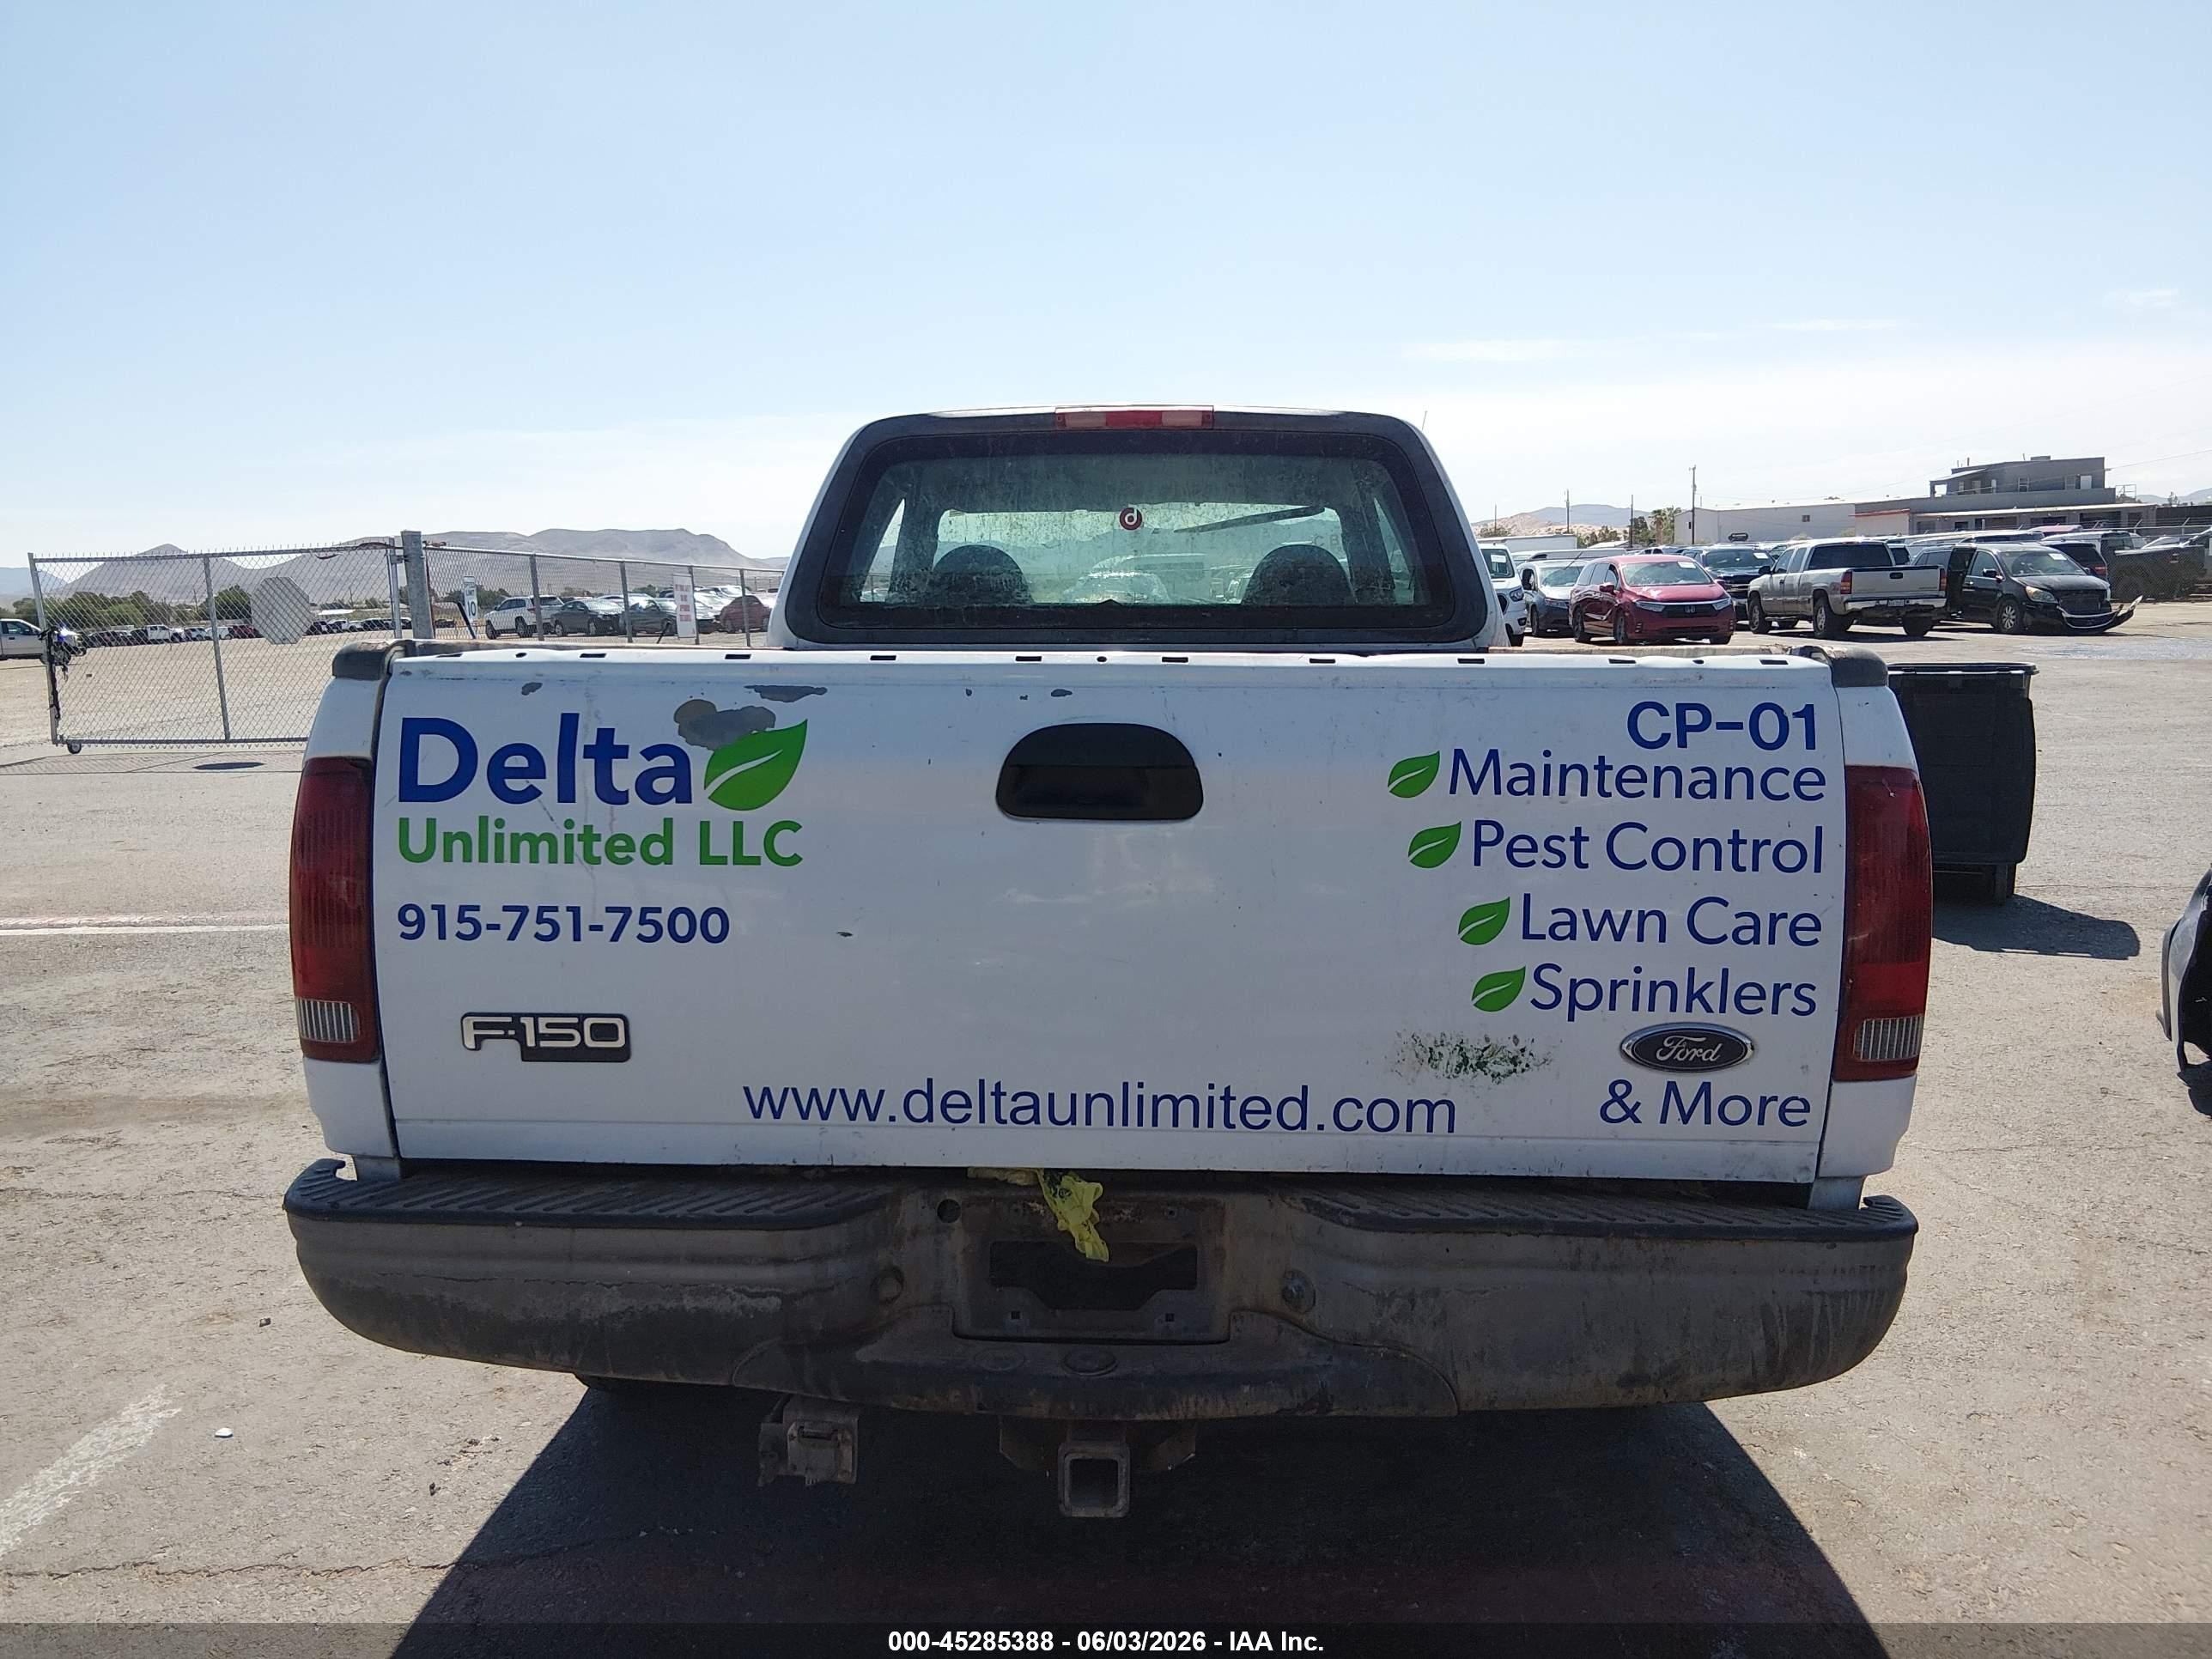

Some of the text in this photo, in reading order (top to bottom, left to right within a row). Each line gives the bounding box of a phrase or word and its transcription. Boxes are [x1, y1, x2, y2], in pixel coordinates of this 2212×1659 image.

[467, 600, 477, 617] 10
[1626, 701, 1816, 751] CP-01
[398, 712, 693, 806] Delta
[1449, 747, 1826, 802] Maintenance
[398, 816, 804, 867] Unlimited LLC
[1473, 819, 1823, 874] Pest Control
[398, 903, 730, 945] 915-751-7500
[1522, 892, 1822, 947] Lawn Care
[1529, 962, 1817, 1023] Sprinklers
[462, 1015, 625, 1050] F-150
[1656, 1035, 1722, 1063] Ford
[743, 1078, 1457, 1134] www.deltaunlimited.com
[1599, 1079, 1812, 1127] & More
